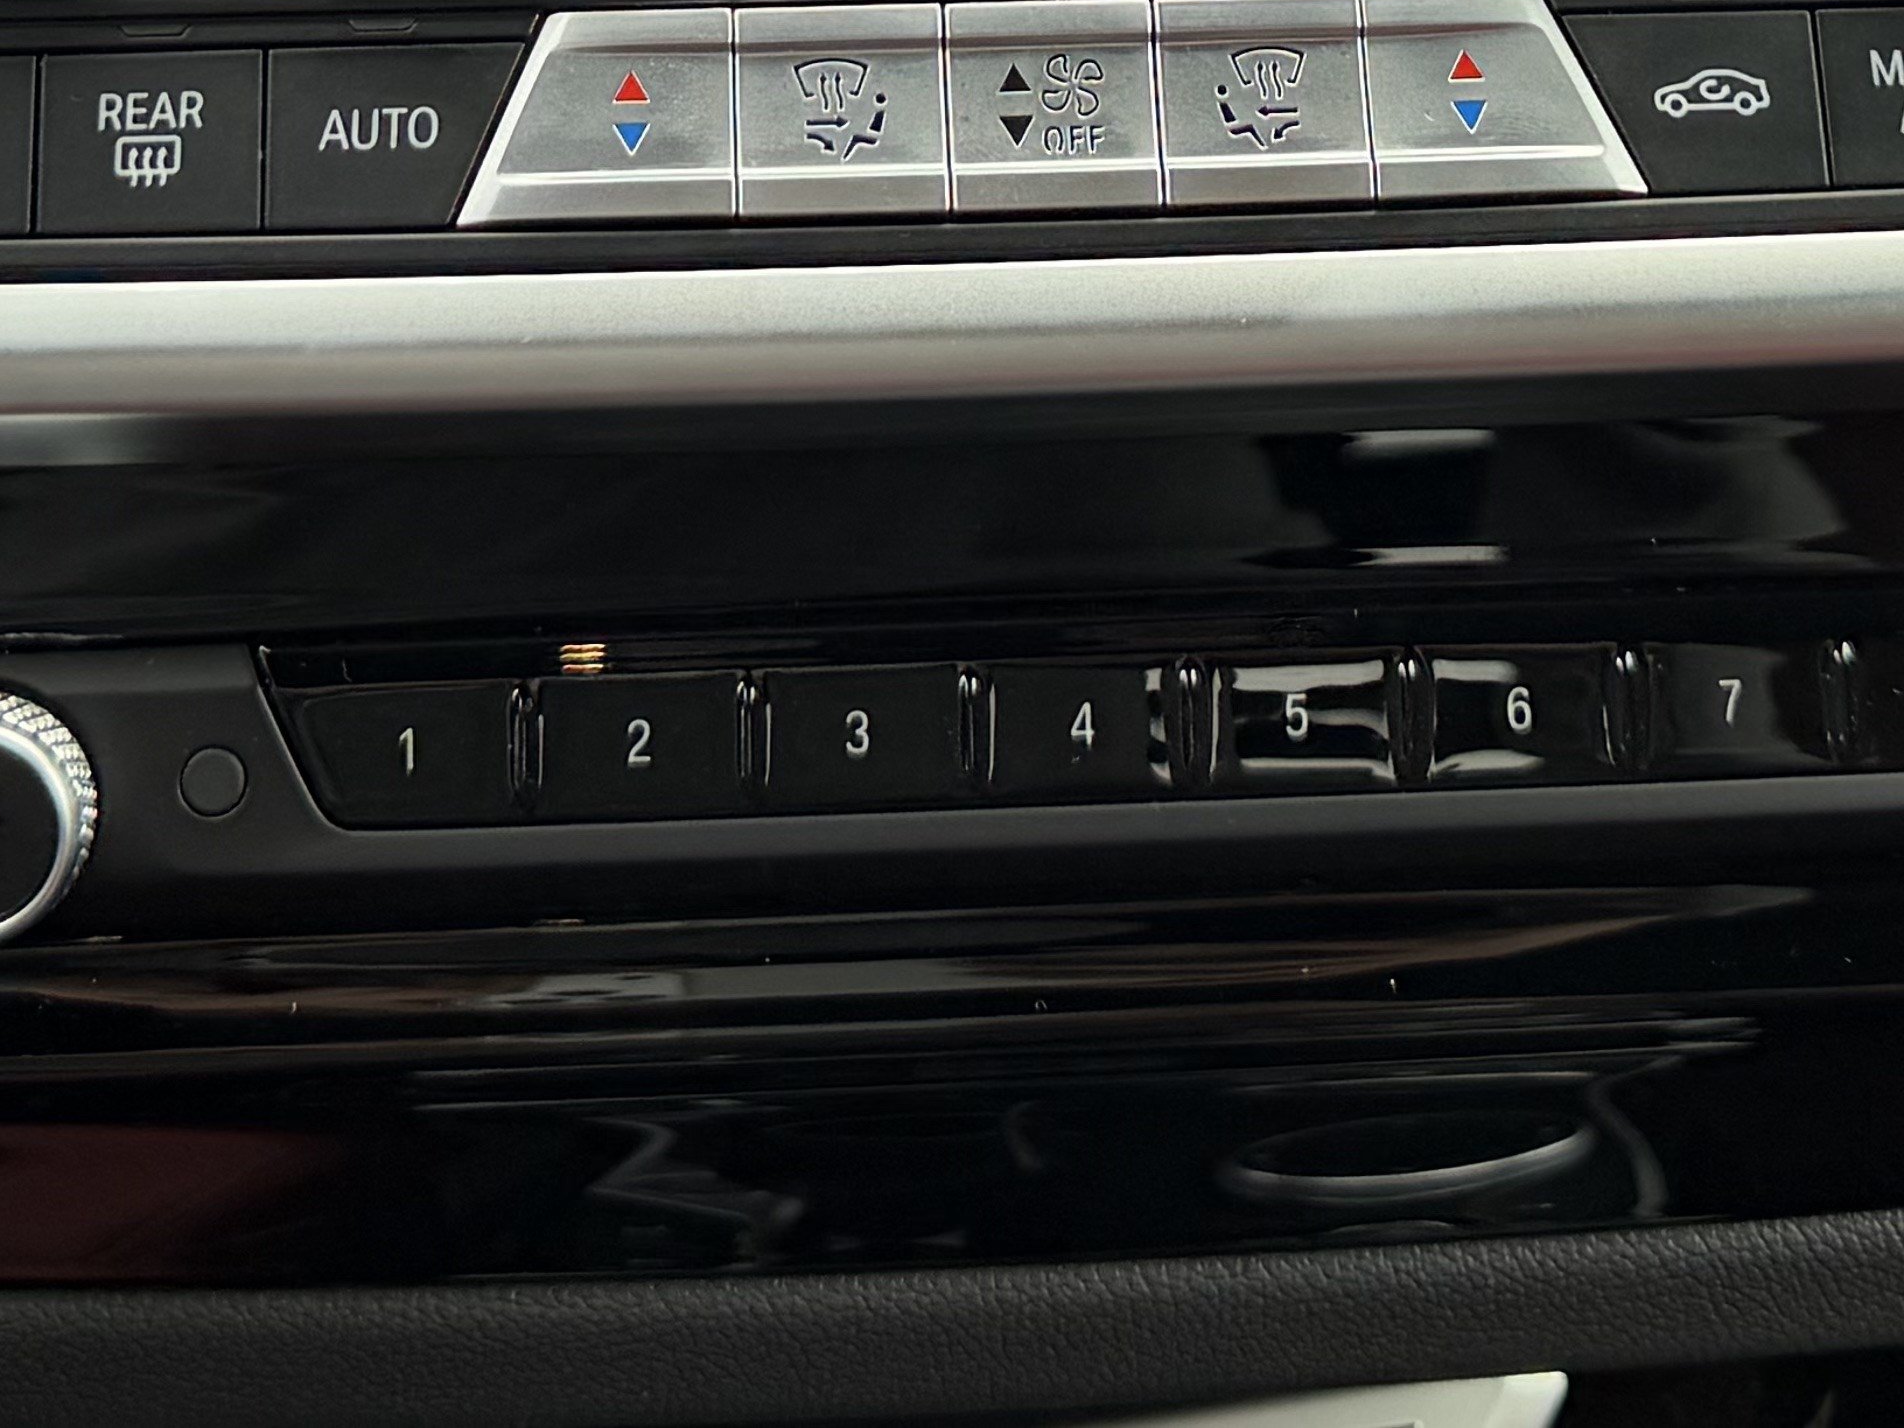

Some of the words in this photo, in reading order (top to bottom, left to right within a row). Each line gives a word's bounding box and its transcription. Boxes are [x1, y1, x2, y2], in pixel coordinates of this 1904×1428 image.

[96, 89, 204, 132] REAR
[318, 104, 440, 152] AUTO
[1042, 122, 1106, 156] OFF
[1069, 700, 1096, 748] 4
[1283, 692, 1310, 741] 5
[1506, 686, 1534, 735] 6
[1717, 677, 1744, 727] 7
[396, 726, 416, 776] 1
[624, 719, 654, 766] 2
[844, 709, 872, 757] 3
